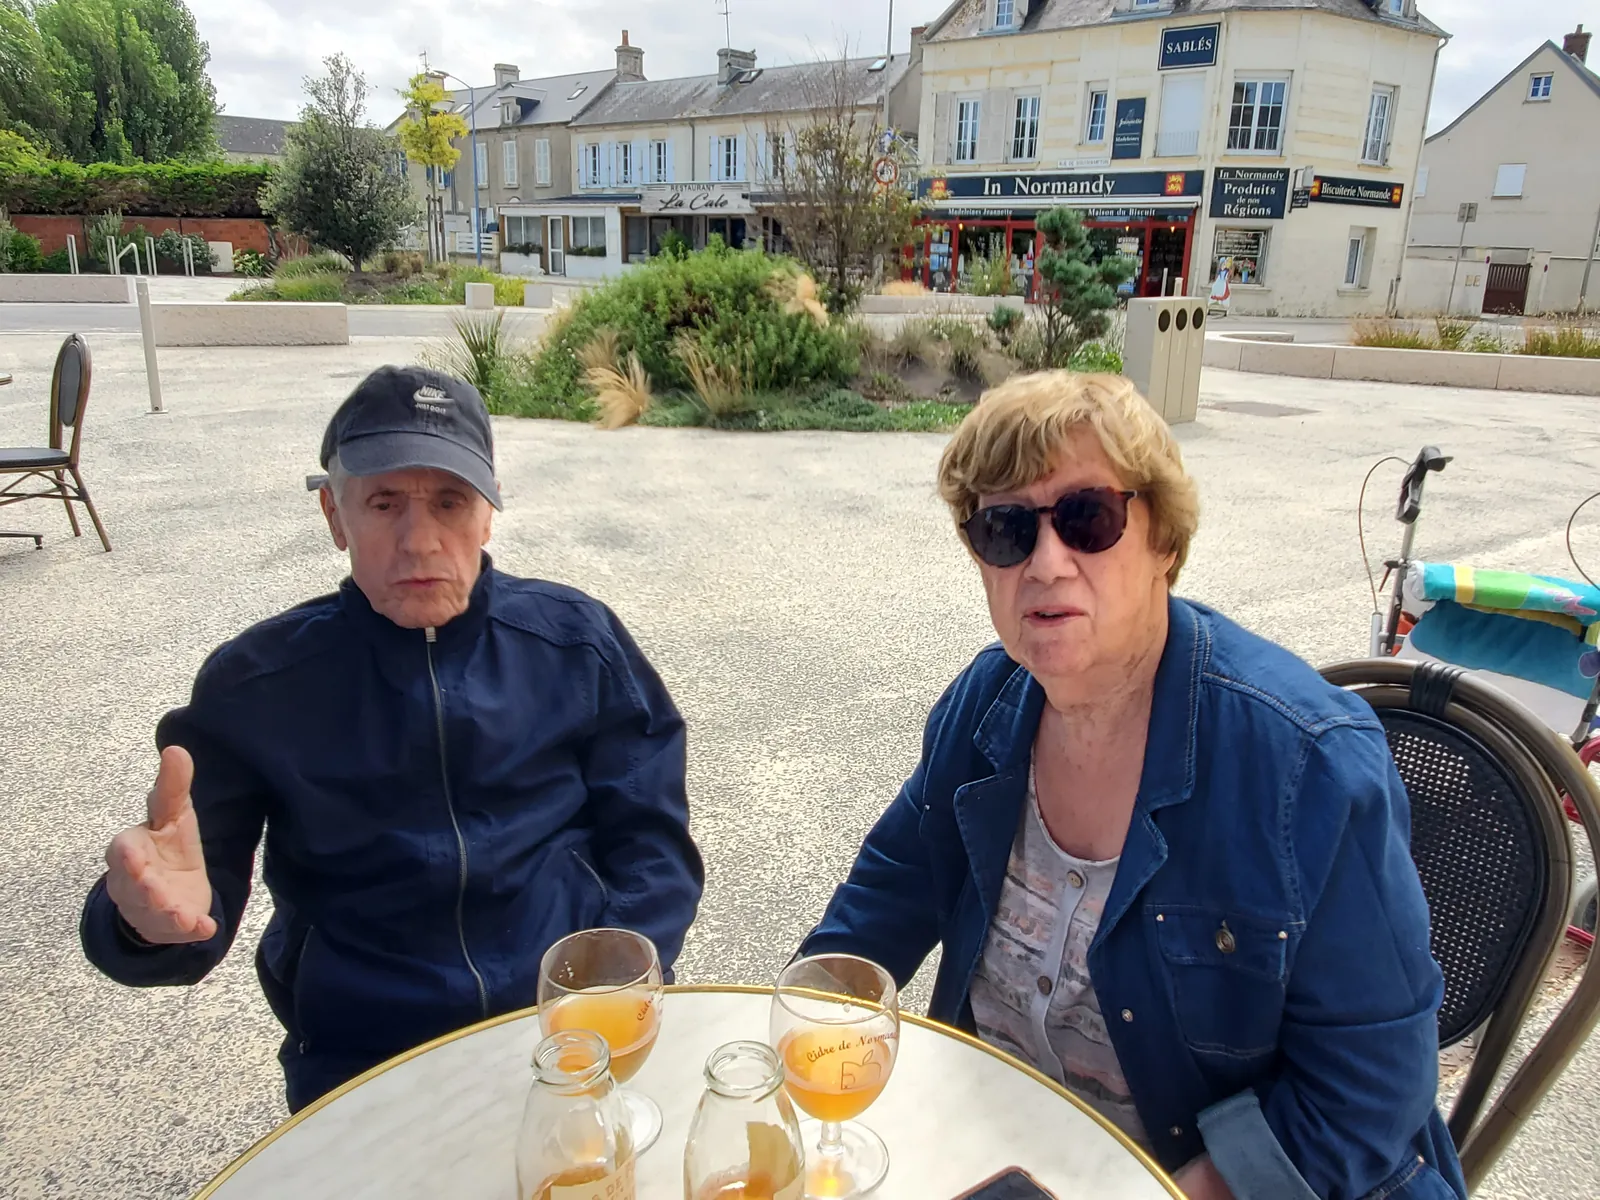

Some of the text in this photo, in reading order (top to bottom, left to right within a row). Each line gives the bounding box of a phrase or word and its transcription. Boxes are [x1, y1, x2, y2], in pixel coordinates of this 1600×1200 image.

[1166, 37, 1212, 54] SABLÉS
[1220, 169, 1285, 181] In Normandy
[670, 184, 715, 192] RESTAURANT
[983, 174, 1116, 198] In Normandy
[1224, 183, 1276, 195] Produits
[1321, 182, 1391, 200] Biscuiterie Normande
[659, 193, 685, 212] La
[1236, 196, 1246, 204] de
[1088, 208, 1156, 216] Maison du Biscuit
[1223, 203, 1272, 217] Régions
[420, 385, 446, 398] NIKE
[806, 1046, 836, 1062] Cidre
[838, 1040, 852, 1051] de
